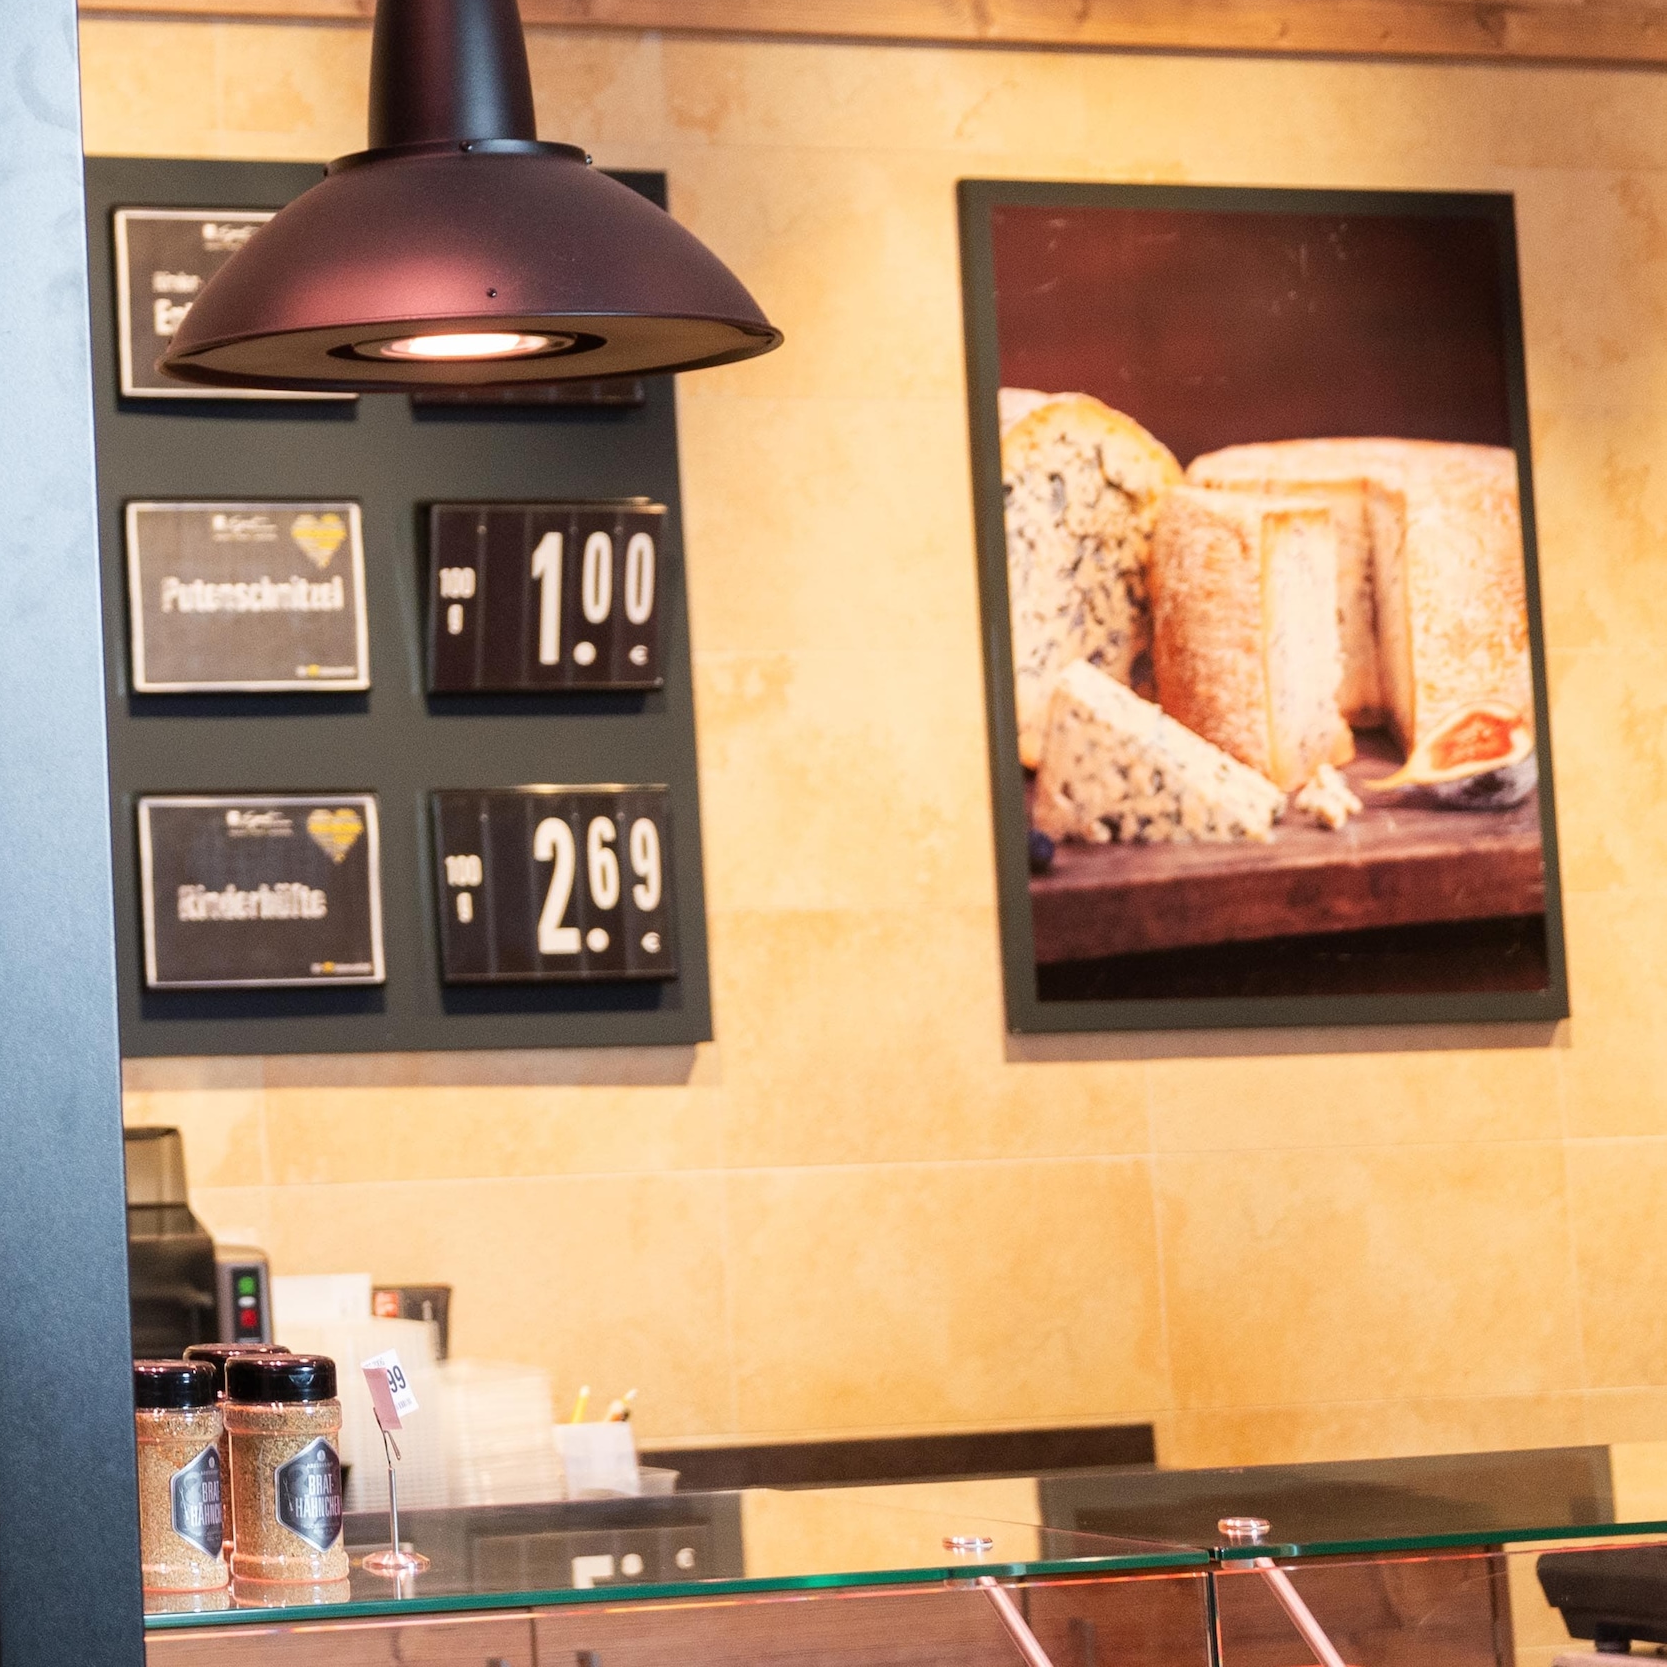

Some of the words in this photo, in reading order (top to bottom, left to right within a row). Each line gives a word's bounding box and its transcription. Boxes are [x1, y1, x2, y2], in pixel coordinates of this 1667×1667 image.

[161, 575, 345, 613] Putenschnitzel
[439, 566, 476, 600] 100
[530, 530, 656, 666] 1.00
[444, 854, 483, 887] 100
[533, 815, 662, 955] 2.69
[307, 1473, 335, 1496] BRAT-
